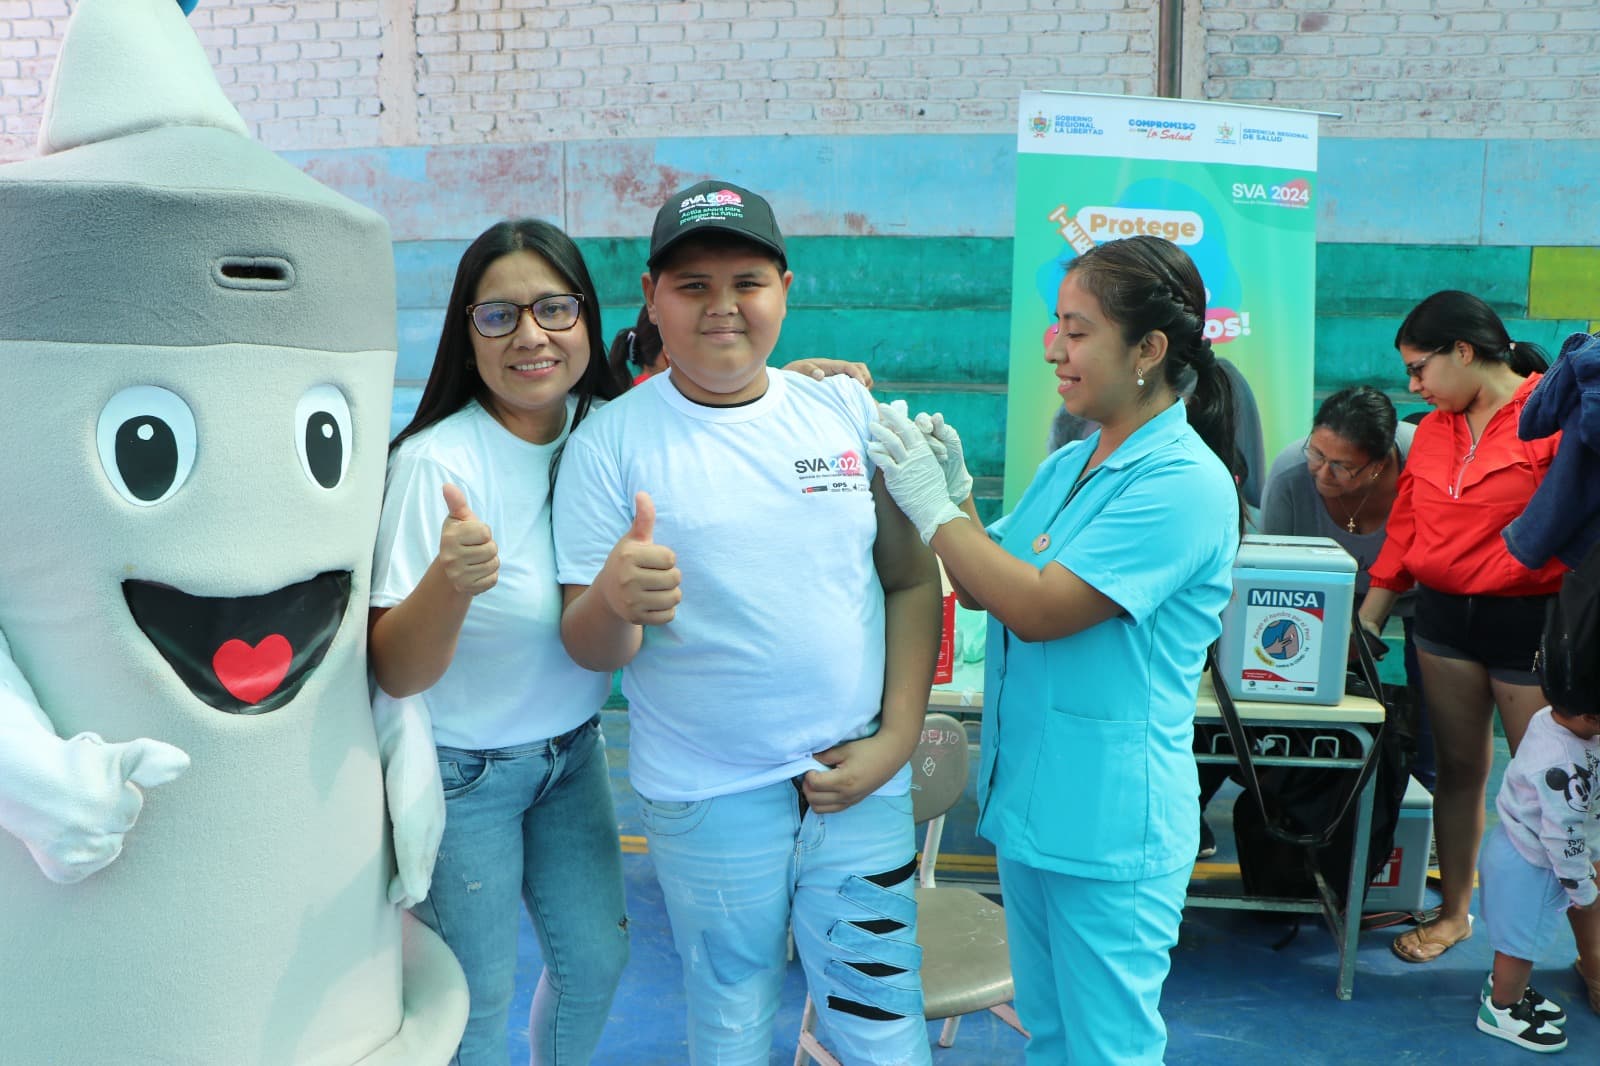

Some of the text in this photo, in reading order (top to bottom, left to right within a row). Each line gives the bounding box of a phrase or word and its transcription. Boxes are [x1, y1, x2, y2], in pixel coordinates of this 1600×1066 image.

[1055, 121, 1096, 129] REGIONAL
[1128, 119, 1196, 130] COMPROMISO
[1066, 128, 1104, 136] LIBERTAD
[1160, 129, 1193, 141] Salud
[1242, 128, 1310, 140] GERENCIA REGIONAL
[1256, 134, 1283, 143] SALUD
[1232, 183, 1310, 203] SVA 2024
[681, 193, 706, 208] SVA
[1089, 214, 1196, 241] Protege
[794, 457, 830, 474] SVA
[1252, 590, 1318, 607] MINSA
